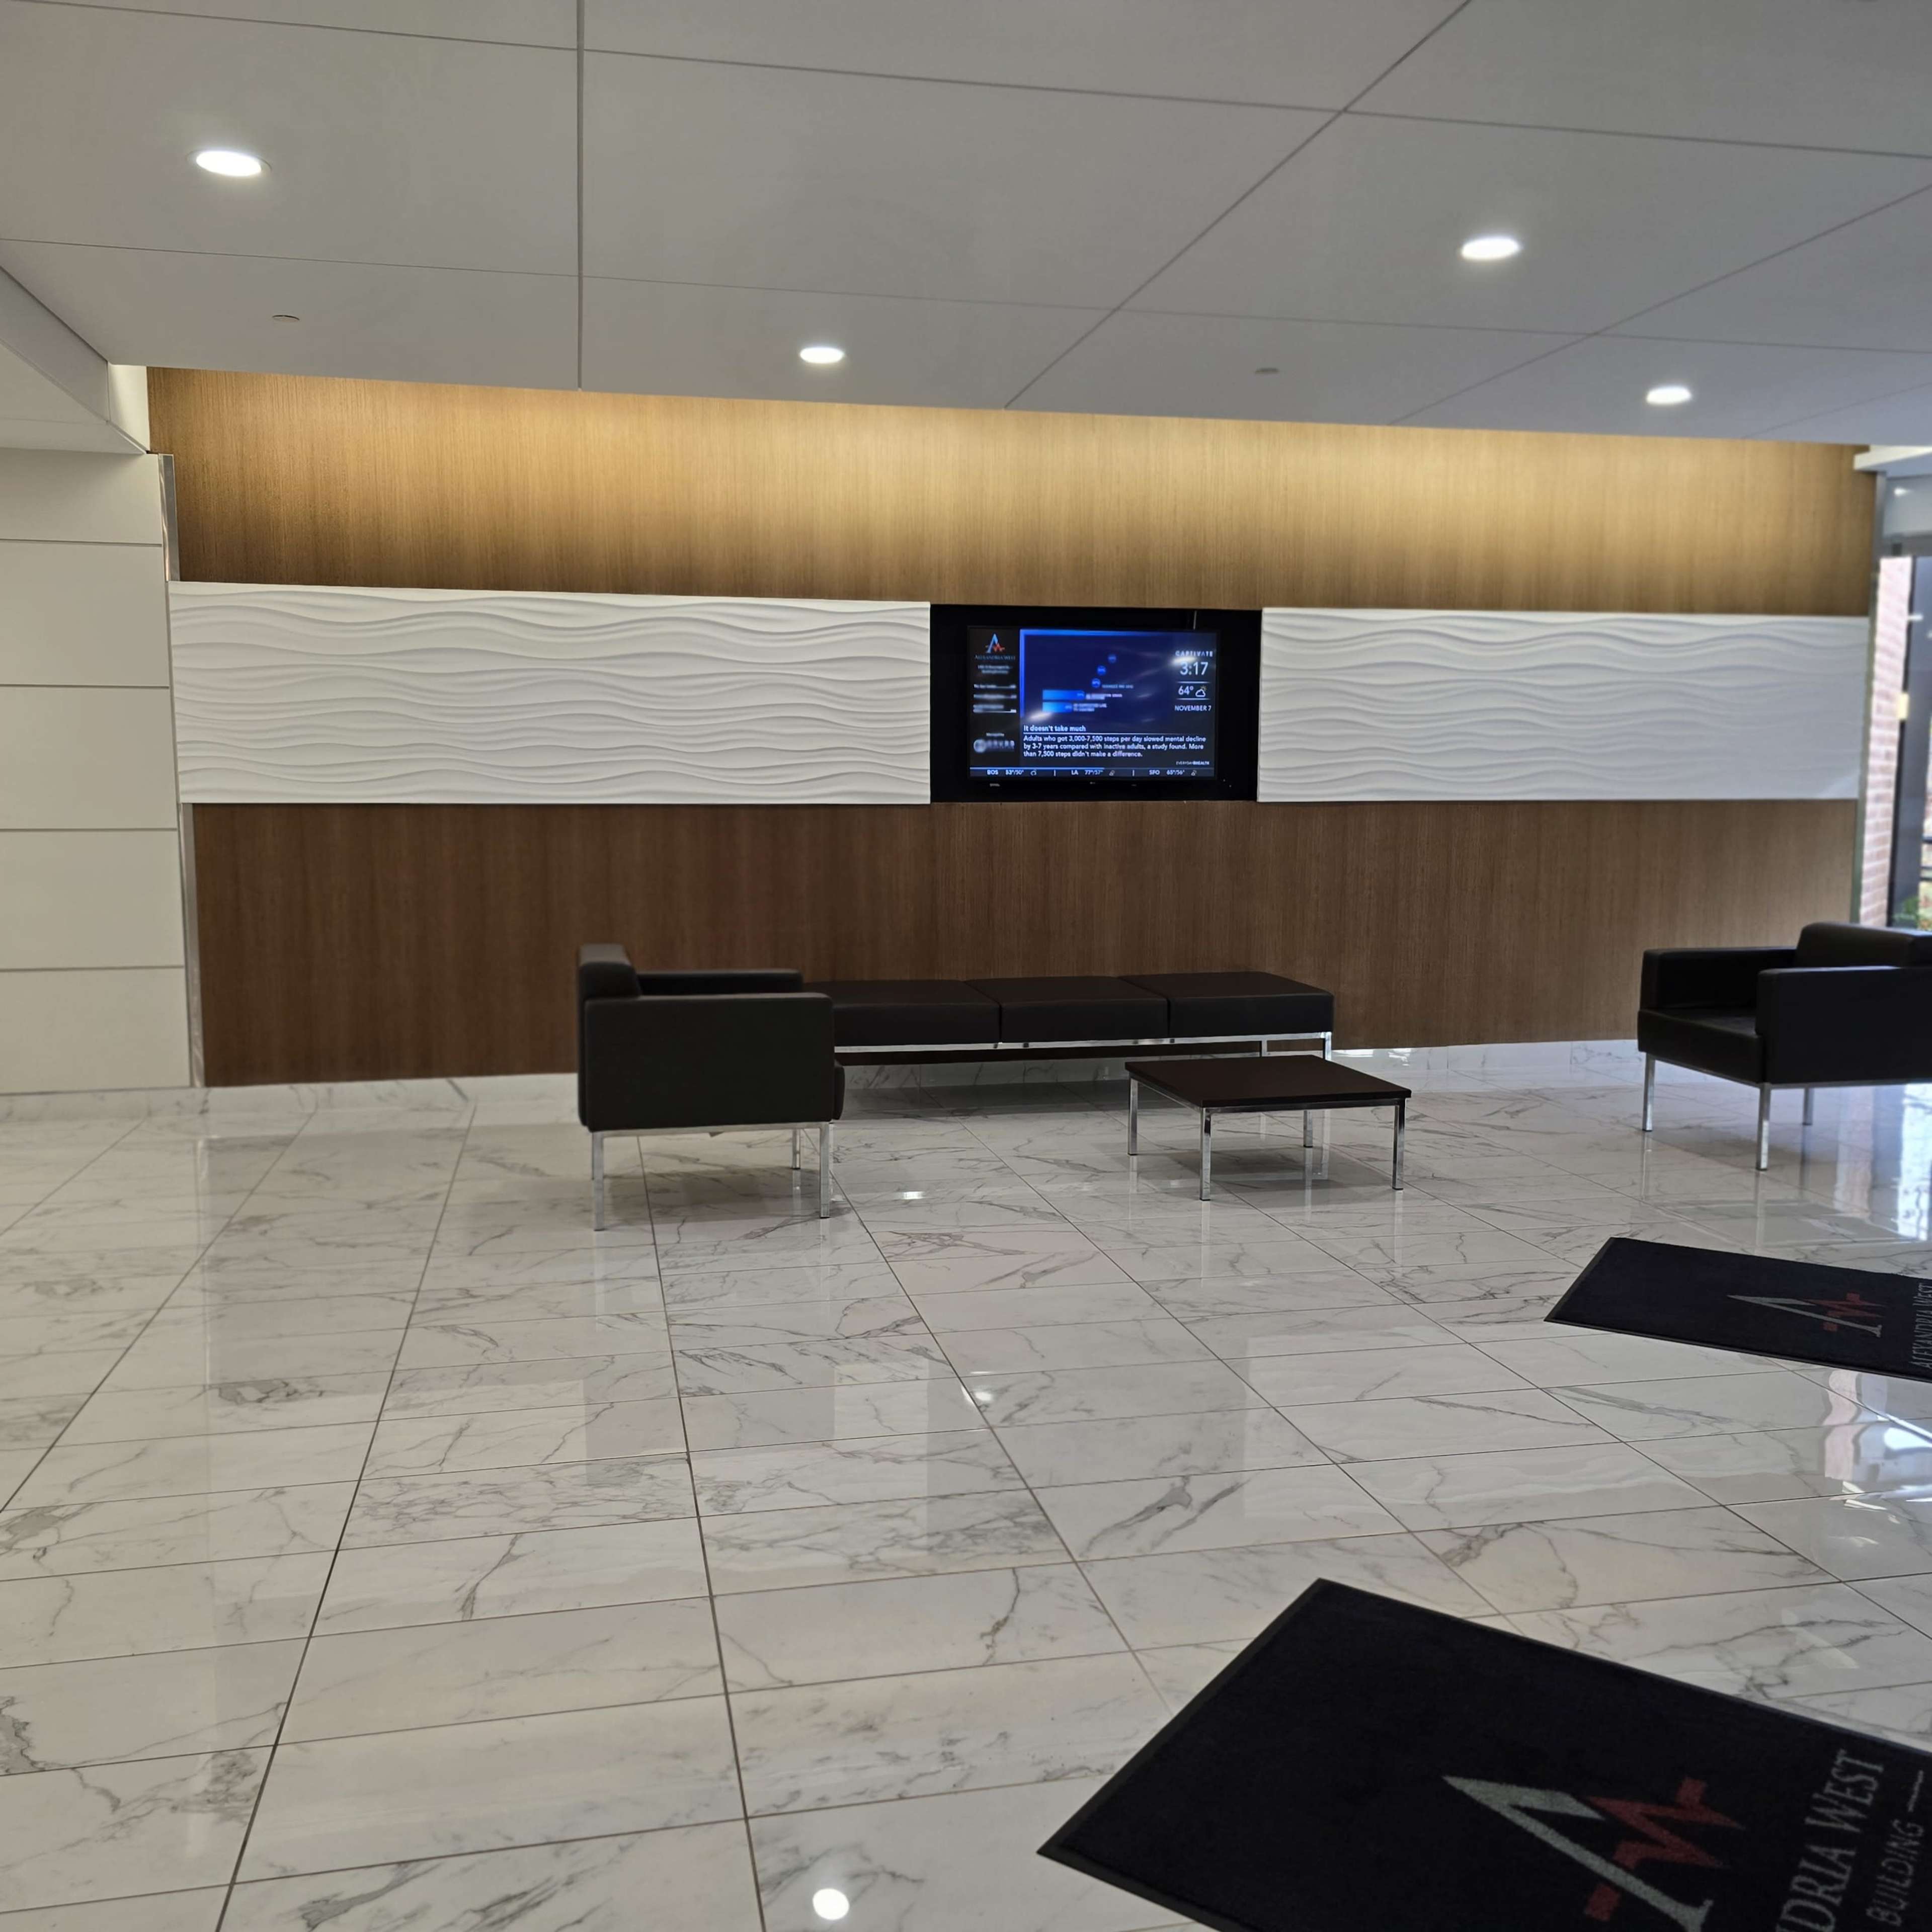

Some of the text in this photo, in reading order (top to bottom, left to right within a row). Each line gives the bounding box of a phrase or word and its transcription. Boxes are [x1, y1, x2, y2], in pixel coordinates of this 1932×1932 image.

[1178, 686, 1193, 695] 64°
[1180, 661, 1209, 675] 3:17
[1775, 1749, 1884, 1932] DRIA WEST
[1866, 1819, 1924, 1926] BUILDING
